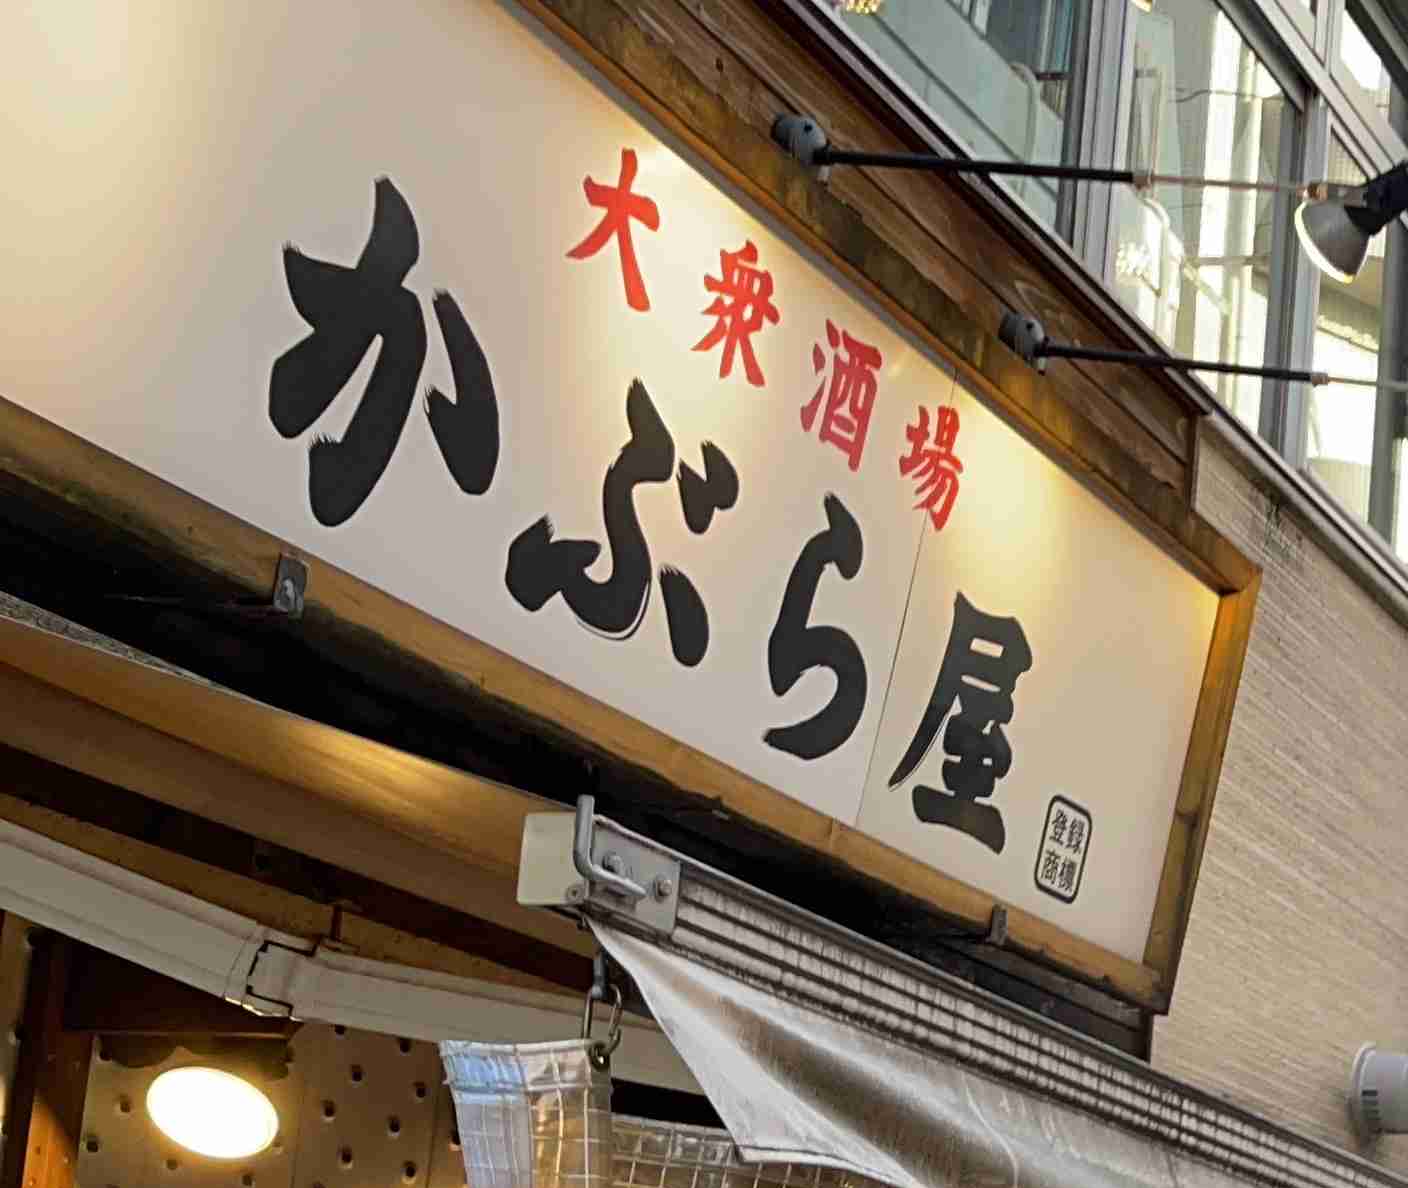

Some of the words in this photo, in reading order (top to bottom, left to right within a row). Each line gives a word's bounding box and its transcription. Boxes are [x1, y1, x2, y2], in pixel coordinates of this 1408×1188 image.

[267, 176, 1034, 855] かぶら屋
[565, 146, 966, 531] 大衆酒場
